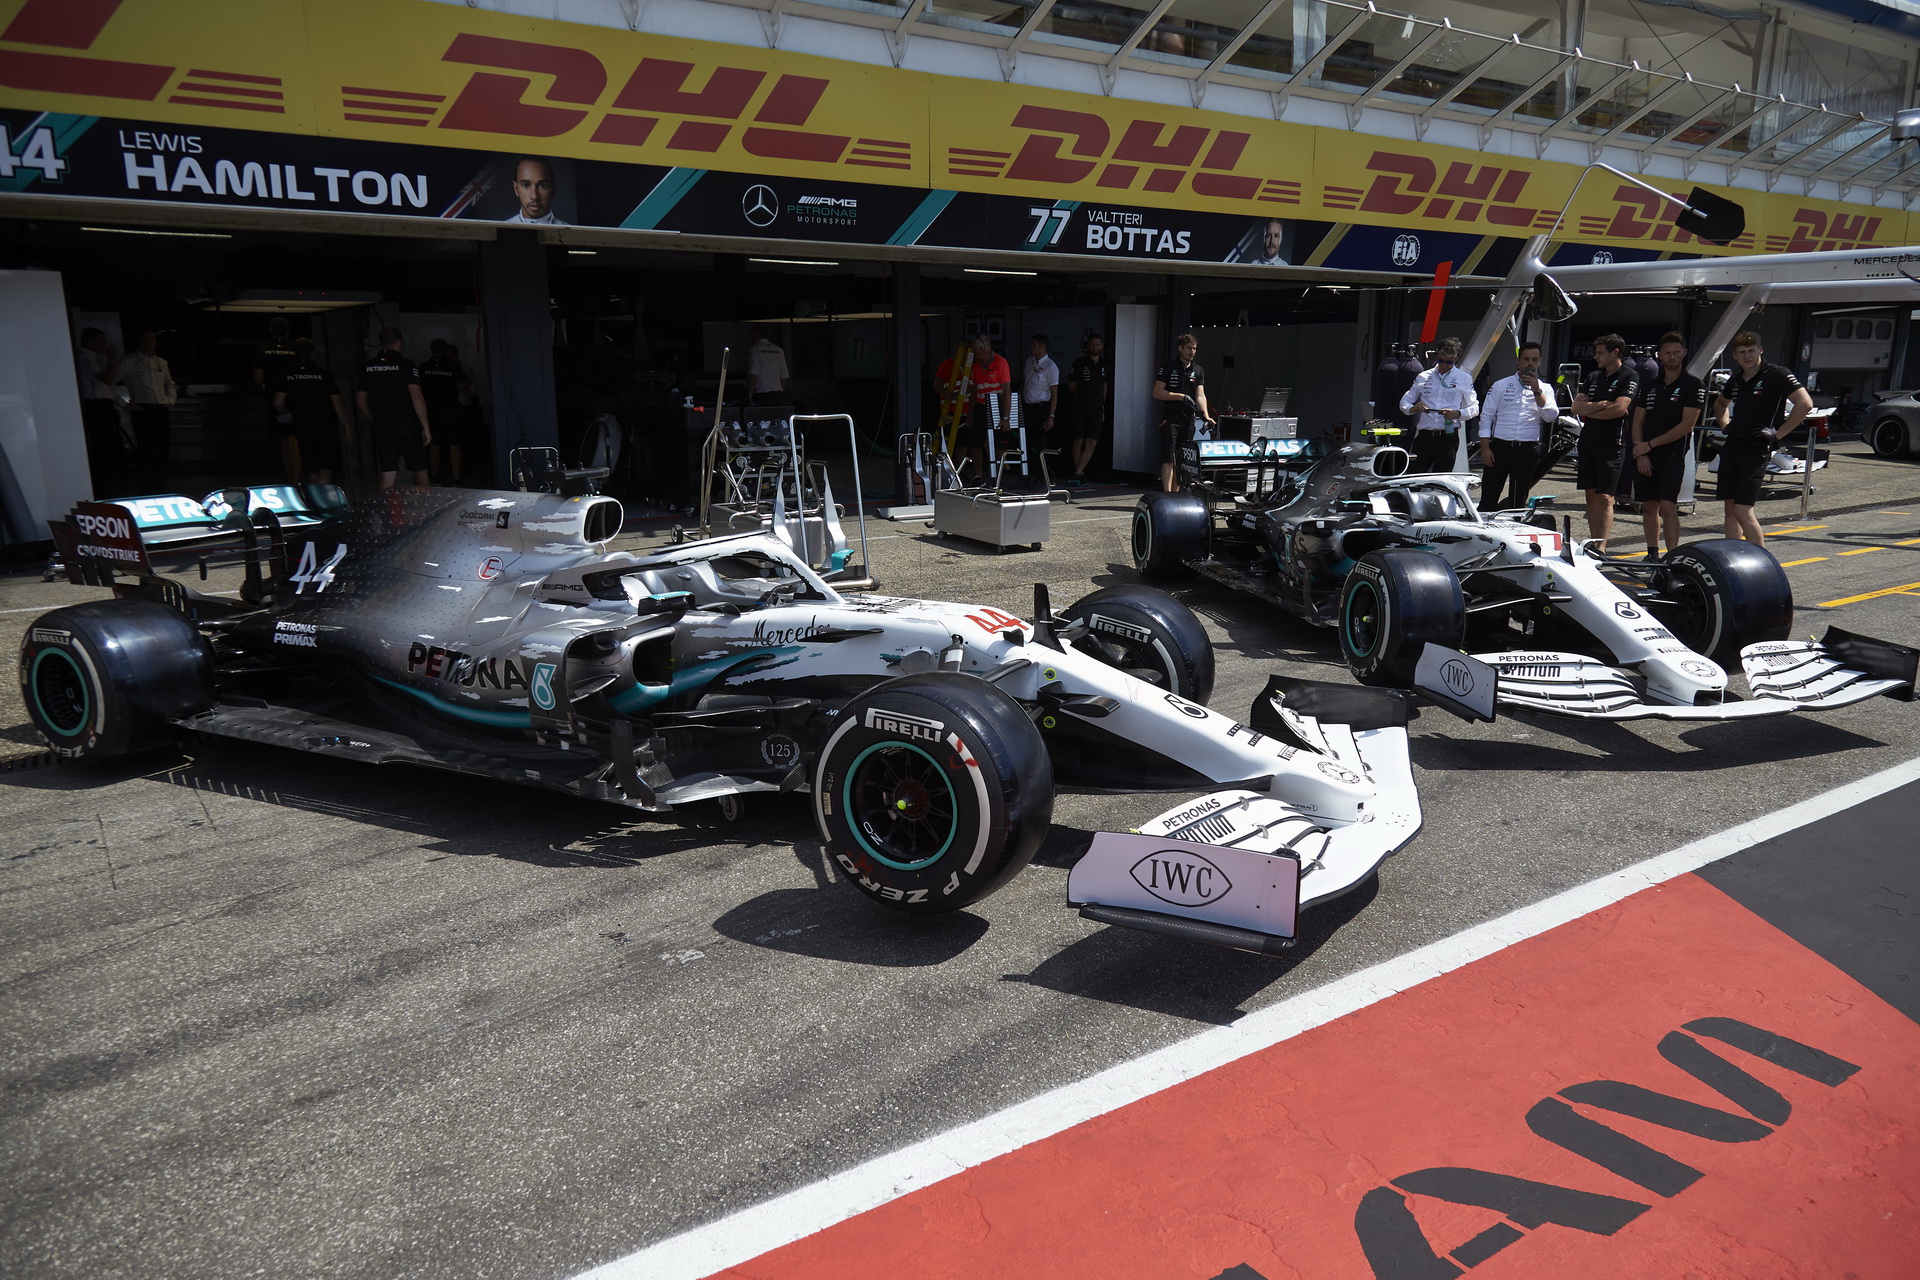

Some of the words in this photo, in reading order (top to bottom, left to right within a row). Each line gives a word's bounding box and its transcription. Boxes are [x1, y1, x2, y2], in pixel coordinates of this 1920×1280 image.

[437, 32, 852, 164] DHL
[119, 130, 203, 154] LEWIS
[1003, 104, 1263, 200] DHL
[122, 152, 429, 209] HAMILTON
[1358, 150, 1538, 228] DHL
[787, 205, 857, 218] PETRONAS
[818, 196, 858, 208] AMG
[796, 216, 857, 226] MOTORSPORT
[1028, 207, 1072, 245] 77
[1088, 210, 1143, 226] VALTTERI
[1605, 185, 1722, 247] DH
[1086, 224, 1191, 254] BOTTAS
[365, 364, 400, 373] PETRONAS
[1201, 440, 1300, 455] PETRNAS
[75, 514, 131, 539] EPSON
[459, 509, 495, 520] Qualcomm
[288, 541, 347, 594] 44
[1354, 561, 1381, 581] PIRELLI
[1672, 554, 1717, 588] ZERO
[554, 584, 584, 592] AMG
[275, 621, 317, 634] PETRONAS
[963, 608, 1030, 635] 44
[1089, 613, 1152, 644] PIRELLI
[31, 627, 72, 647] PIRELLI
[273, 632, 318, 648] PRIMAX
[1498, 654, 1560, 662] PETRONAS
[1446, 664, 1470, 692] IWC
[864, 707, 945, 743] PIRELLI
[769, 744, 791, 757] 125
[1162, 798, 1222, 831] PETRONAS
[836, 853, 929, 904] ZERO
[942, 870, 961, 896] P
[1149, 857, 1213, 899] IWC
